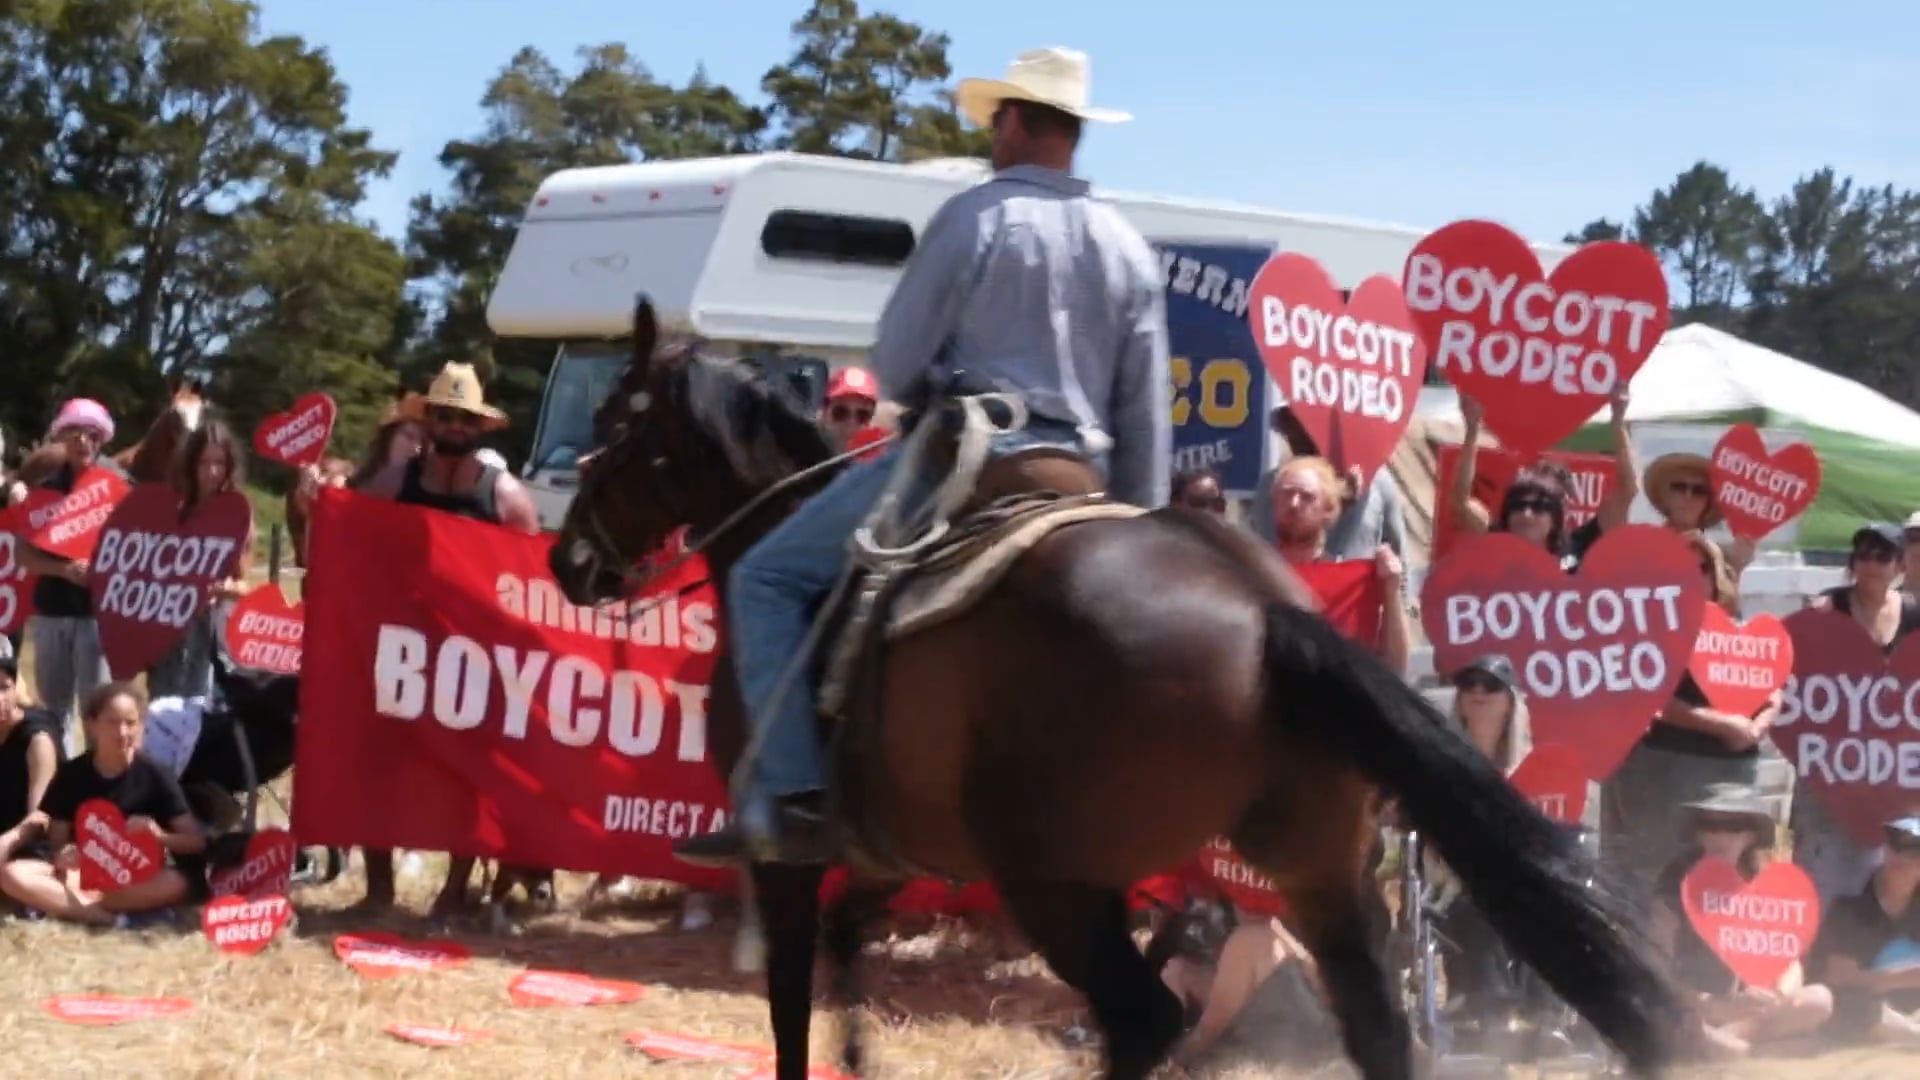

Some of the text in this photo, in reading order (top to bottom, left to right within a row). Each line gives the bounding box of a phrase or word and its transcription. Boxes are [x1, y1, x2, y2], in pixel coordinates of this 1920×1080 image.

[1406, 254, 1656, 352] BOYCOTT
[1262, 295, 1414, 376] BOYCOTT
[1436, 321, 1617, 395] RODEO
[1291, 356, 1403, 422] RODEO
[1168, 439, 1233, 473] TRE
[1717, 448, 1808, 501] BOYCOTT
[1719, 481, 1785, 522] RODEO
[95, 528, 236, 579] BOYCOTT
[101, 573, 199, 628] RODEO
[238, 610, 304, 640] BOYCO
[1446, 585, 1681, 645] BOYCOTT
[1523, 641, 1667, 699] ODEO
[1695, 630, 1779, 660] BOYCOTT
[1708, 662, 1774, 689] RODEO
[1798, 733, 1920, 788] RODE
[604, 794, 705, 838] DIRECT
[1702, 890, 1807, 926] BOYCOTT
[1719, 927, 1799, 959] RODEO
